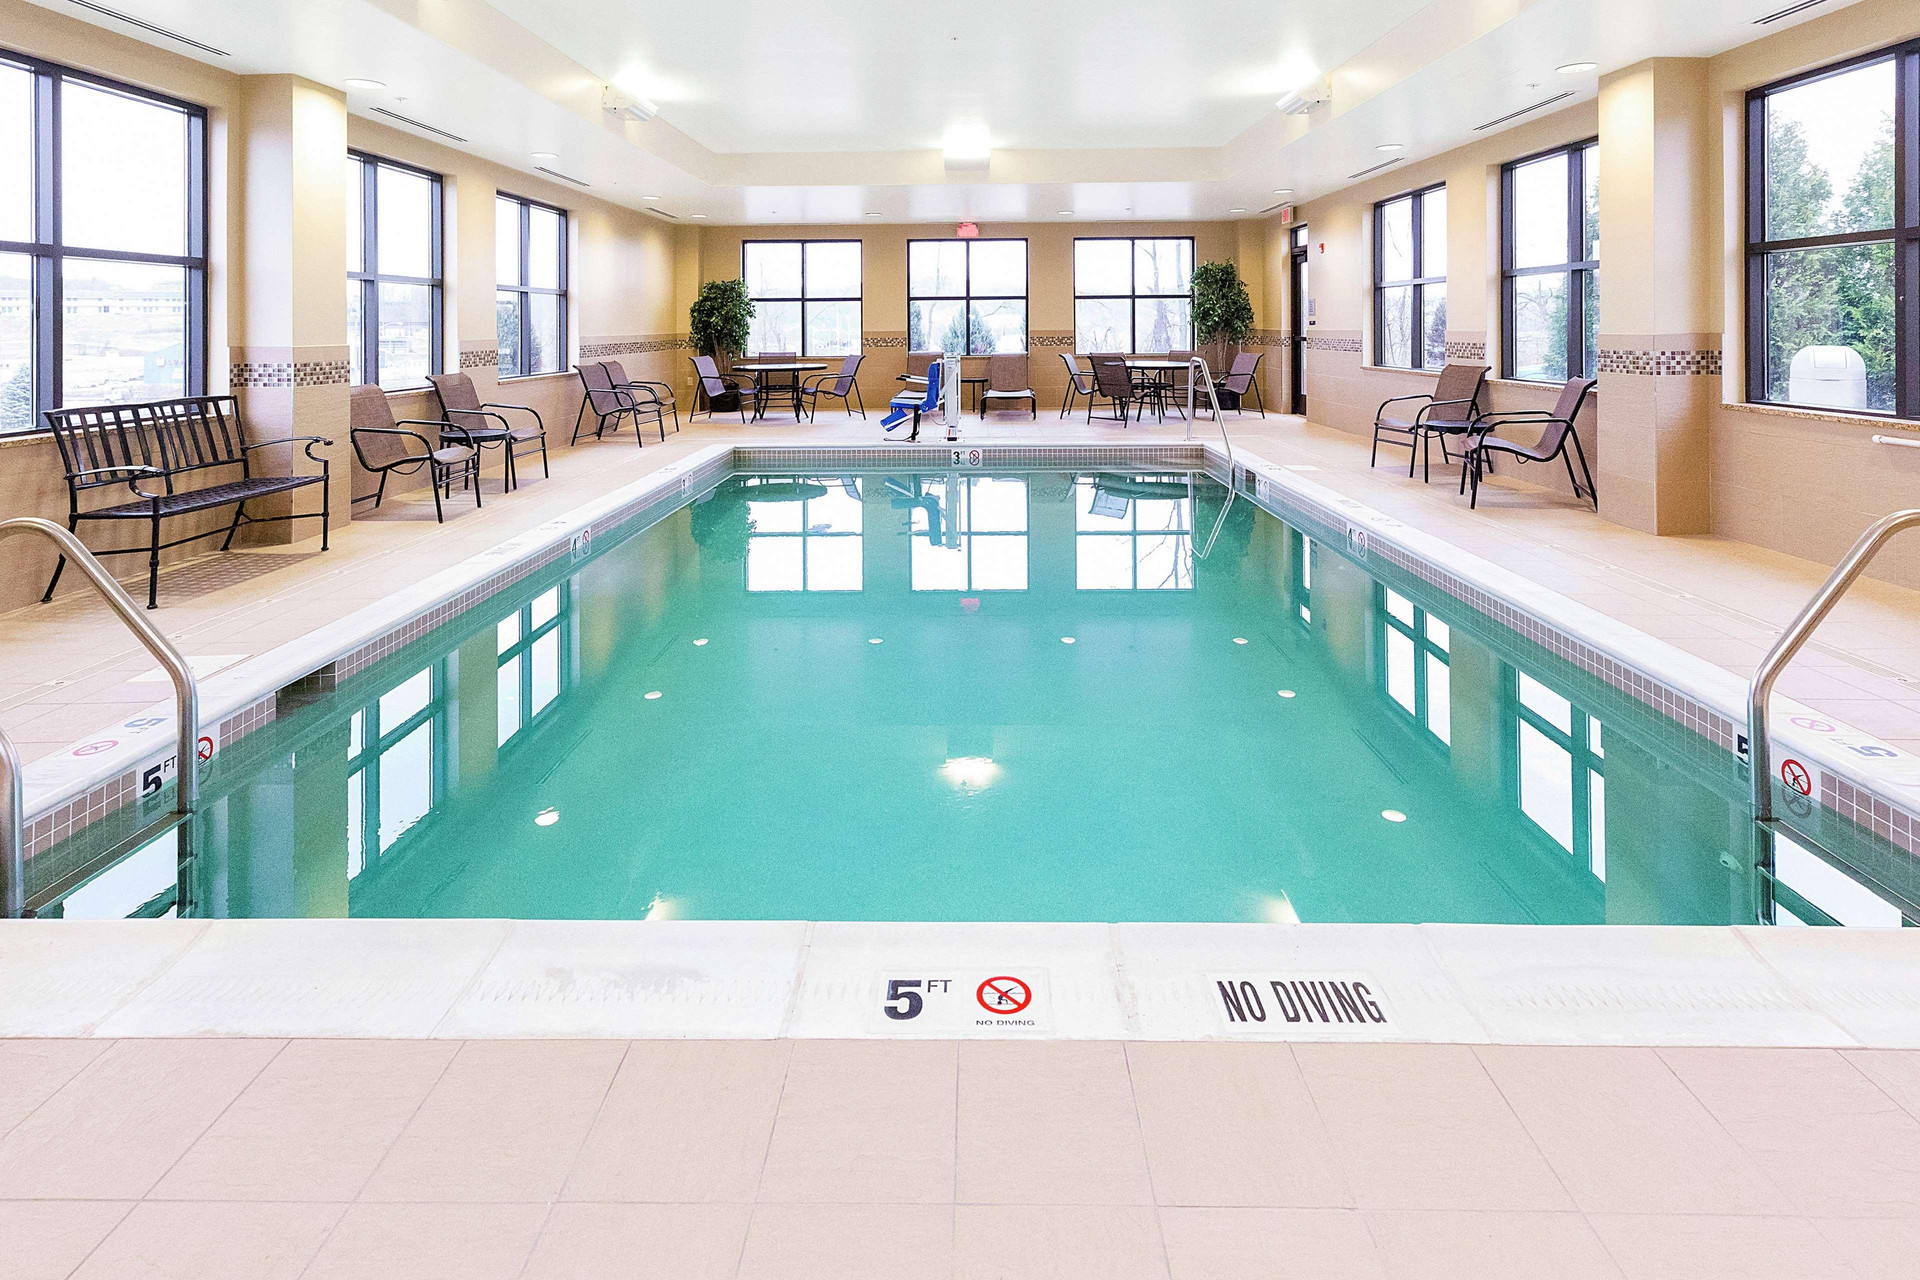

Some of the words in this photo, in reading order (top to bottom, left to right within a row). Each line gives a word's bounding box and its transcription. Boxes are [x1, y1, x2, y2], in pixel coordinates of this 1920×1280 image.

[124, 718, 169, 727] 5
[1848, 746, 1898, 758] 5
[142, 764, 162, 798] 5
[163, 755, 177, 773] FT
[884, 979, 923, 1020] 5
[927, 979, 952, 993] FT
[1217, 981, 1266, 1022] NO
[1270, 981, 1388, 1023] DIVING
